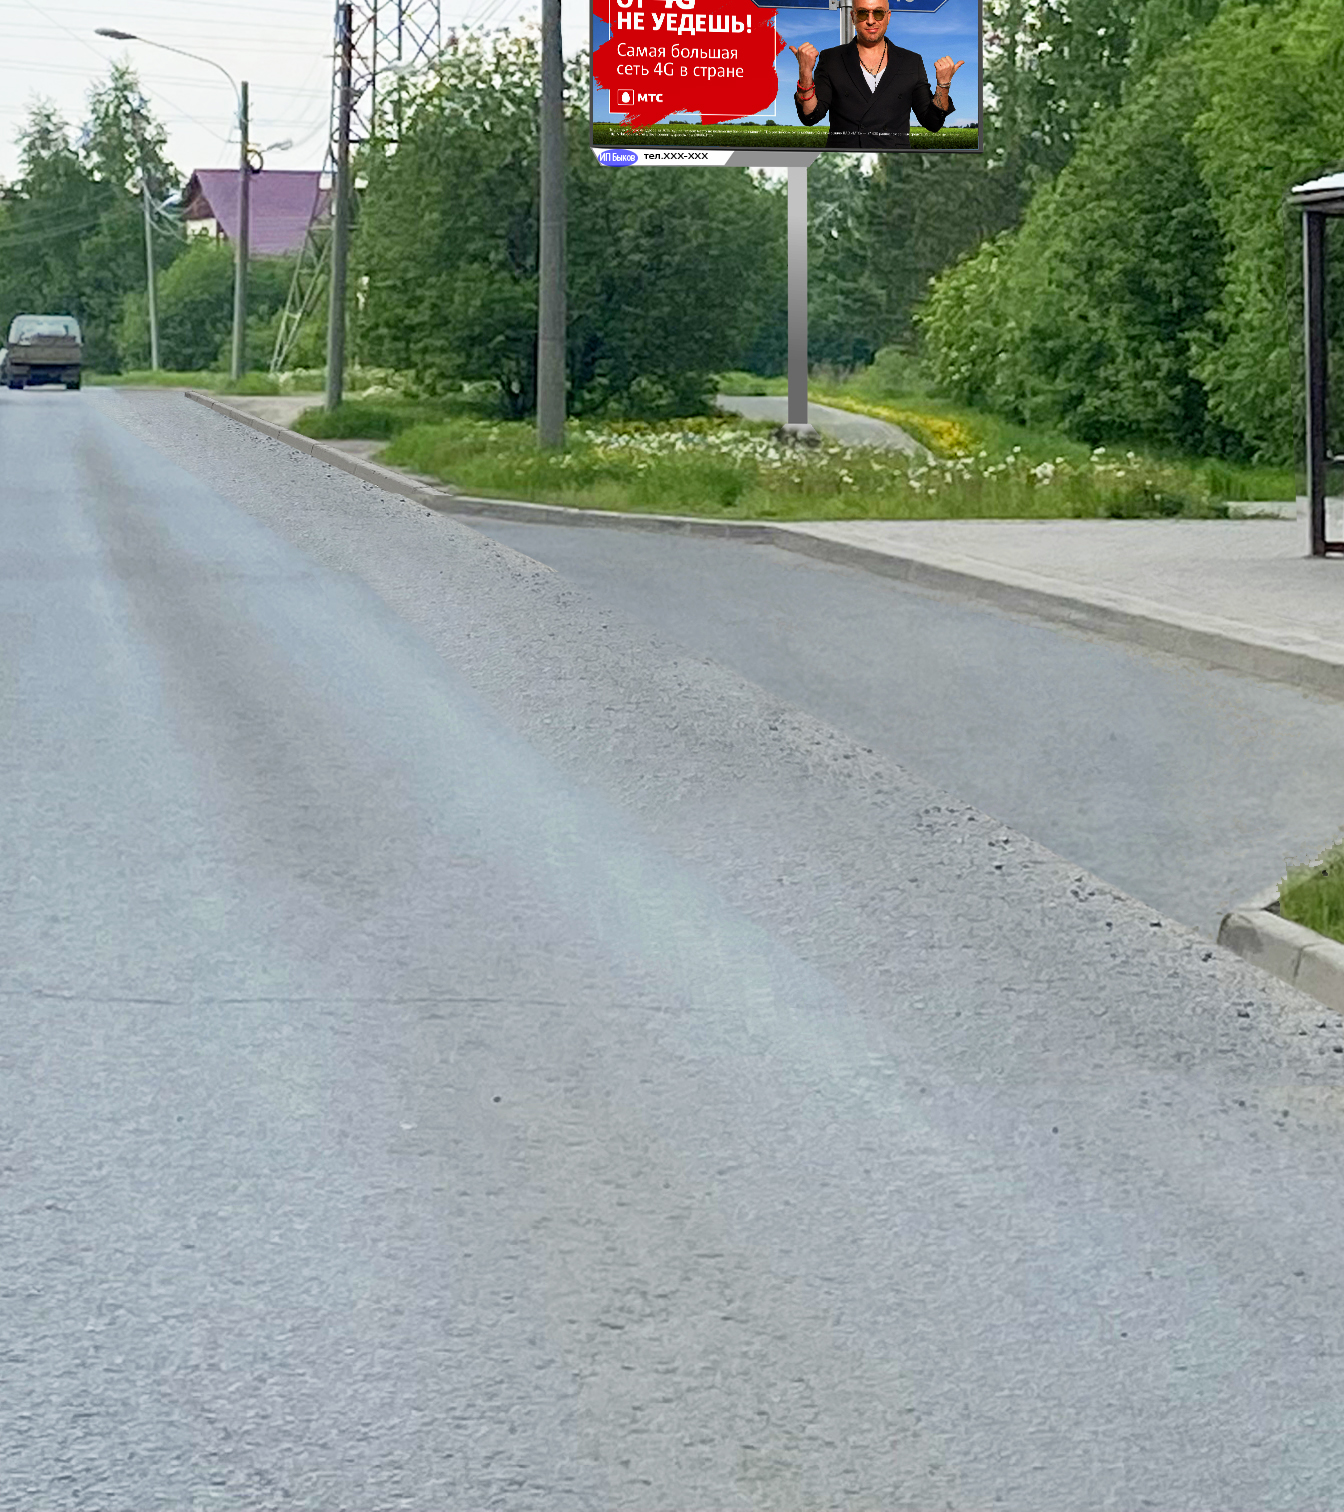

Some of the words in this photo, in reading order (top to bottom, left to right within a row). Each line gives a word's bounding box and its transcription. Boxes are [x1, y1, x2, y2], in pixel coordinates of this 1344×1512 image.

[617, 11, 645, 31] НЕ
[651, 12, 752, 36] УЕДЕШЬ!
[617, 42, 666, 58] Самая
[671, 43, 738, 60] большая
[616, 63, 650, 76] сеть
[653, 62, 674, 77] 4G
[680, 66, 688, 77] в
[693, 66, 744, 81] стране
[637, 93, 664, 103] МТС
[599, 152, 611, 162] ИП
[612, 152, 636, 163] Быков
